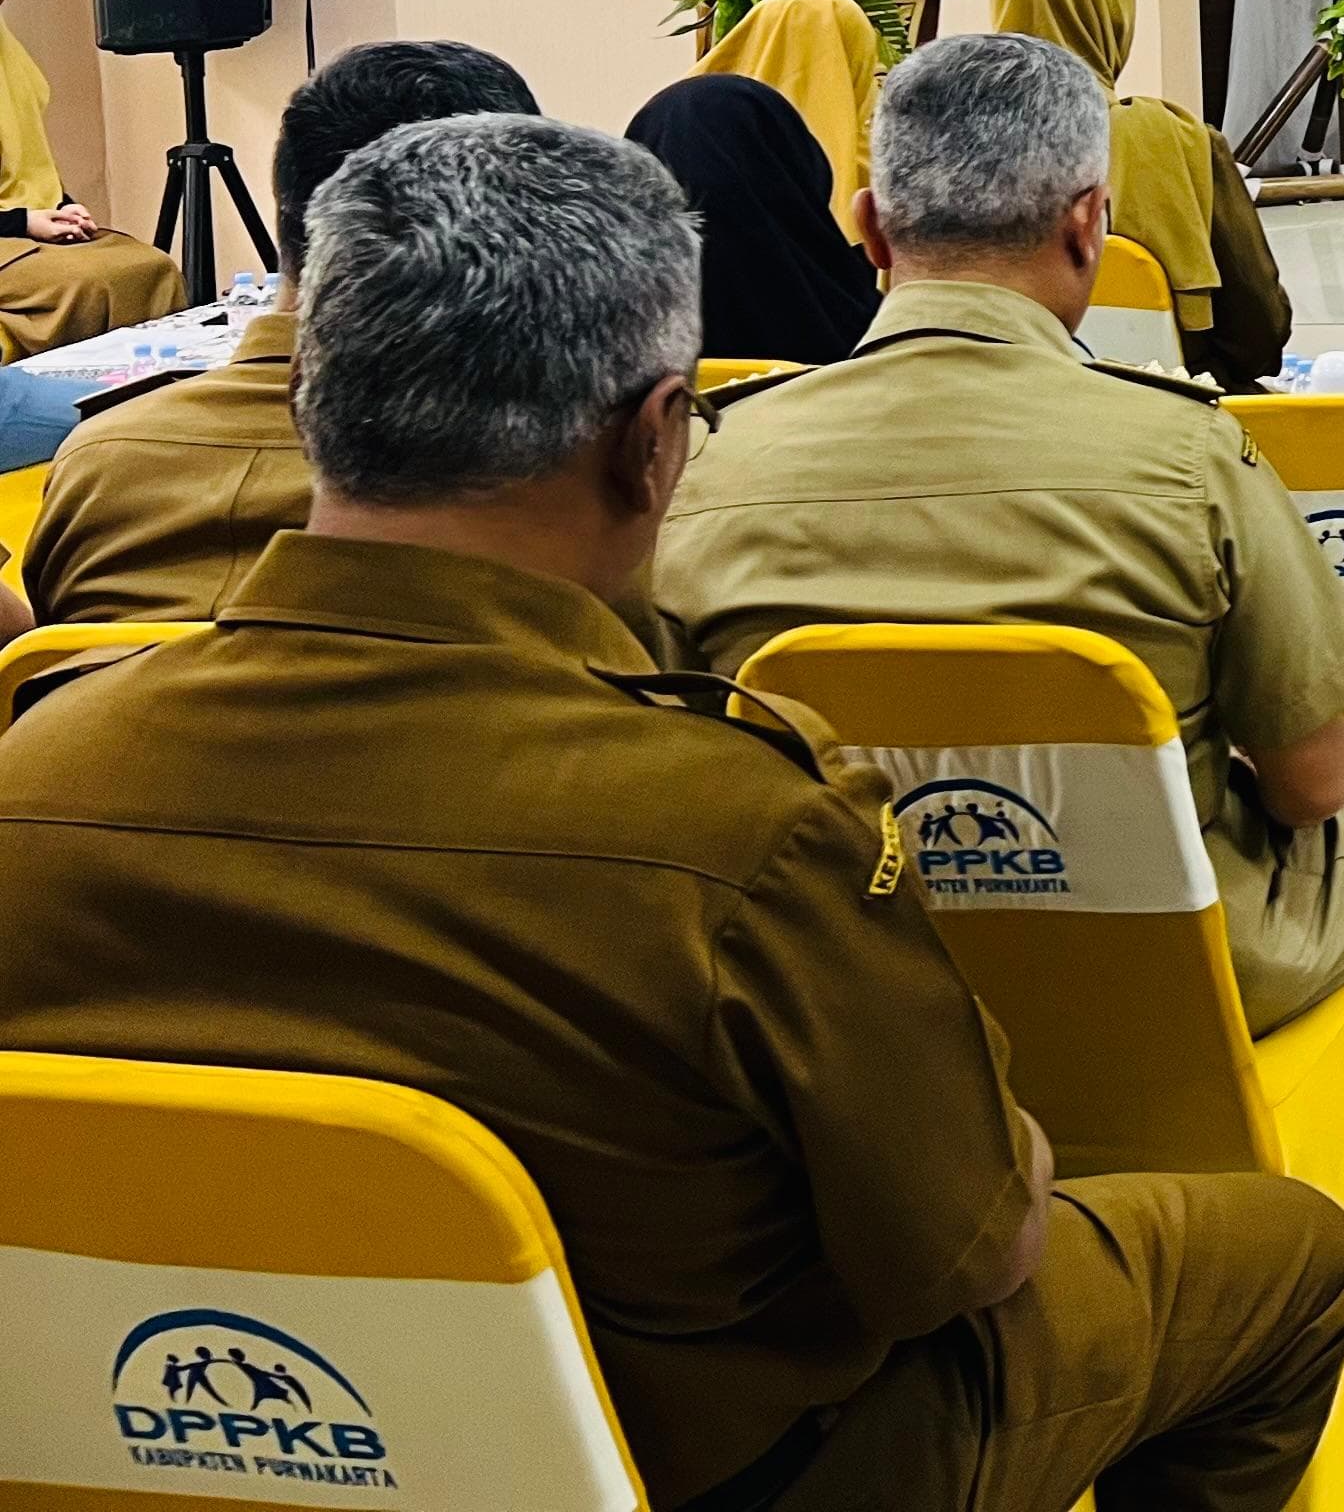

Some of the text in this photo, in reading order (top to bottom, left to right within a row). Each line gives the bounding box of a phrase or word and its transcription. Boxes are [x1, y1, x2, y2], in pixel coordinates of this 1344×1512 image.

[917, 849, 1066, 876] PPKB
[112, 1403, 387, 1461] DPPKB
[253, 1455, 399, 1489] PURWAKARTA
